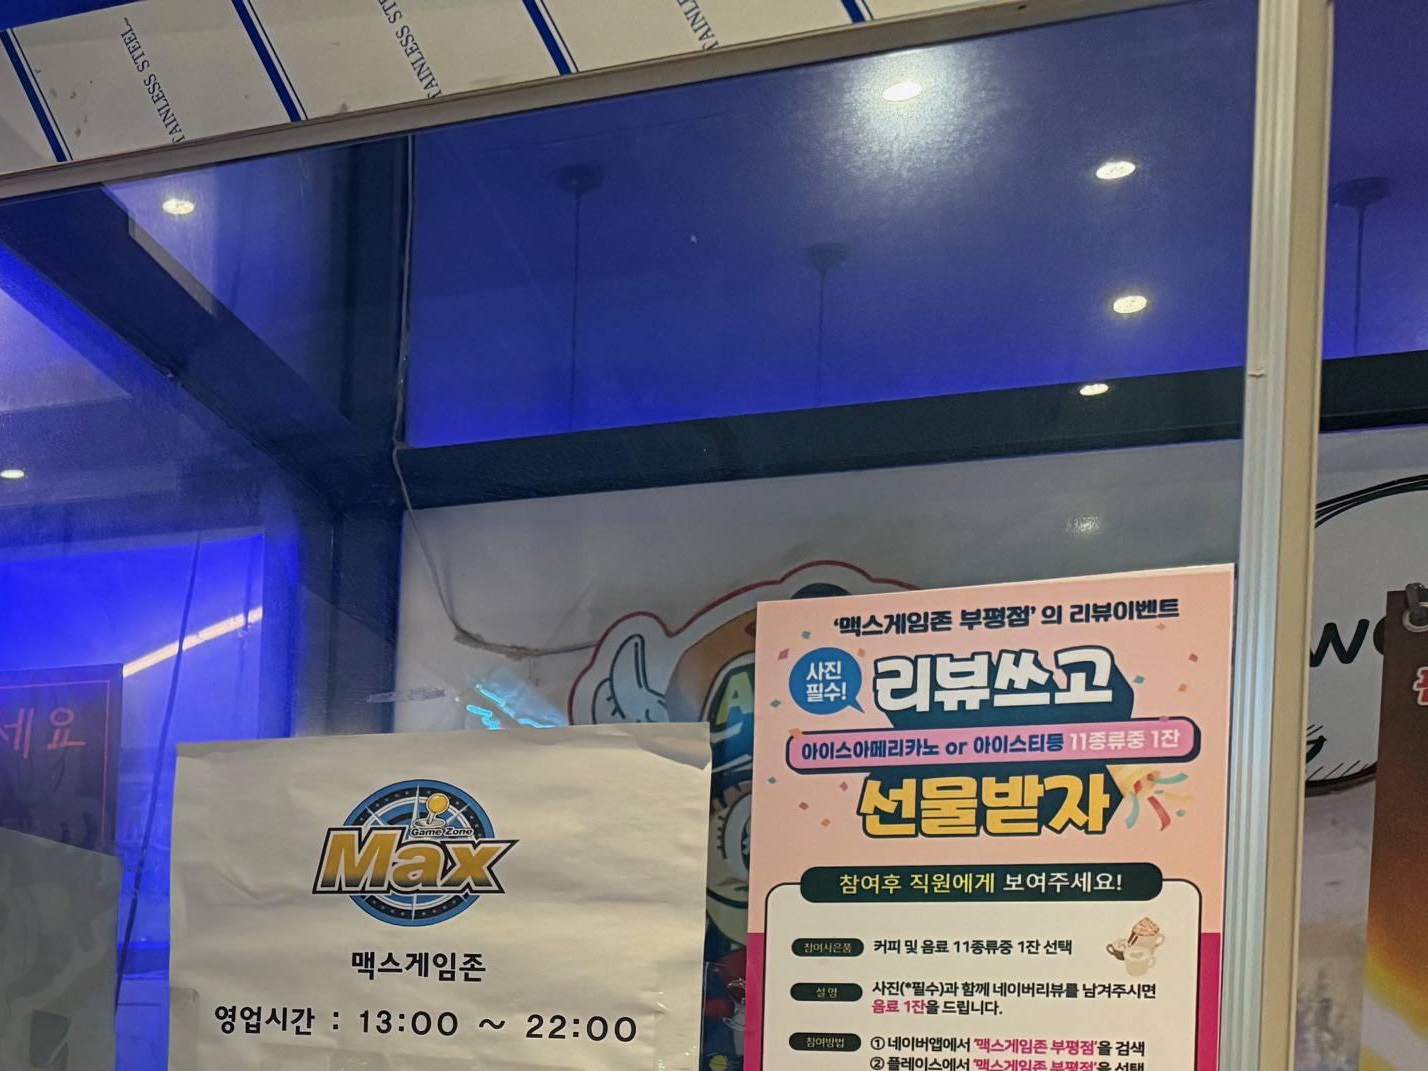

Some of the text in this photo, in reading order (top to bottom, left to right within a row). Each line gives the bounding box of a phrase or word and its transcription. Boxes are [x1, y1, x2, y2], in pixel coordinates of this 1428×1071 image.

[1041, 604, 1063, 626] 의
[1069, 596, 1181, 625] 리뷰이벤트
[805, 659, 843, 682] 사진
[874, 644, 1115, 714] 리뷰쓰고
[805, 680, 848, 703] 필수!
[801, 726, 1181, 762] 아이스아메리카노 or 아이스티등 11종류중 1잔
[859, 772, 1112, 838] 선물받자
[410, 826, 474, 838] Game Zone
[313, 828, 518, 893] Max
[839, 870, 1124, 896] 참여후 직원에게 보여주세요!
[873, 939, 902, 956] 커피
[904, 940, 919, 956] 및
[921, 940, 950, 955] 음료
[953, 939, 1014, 956] 11종류중
[1017, 939, 1041, 955] 1잔
[1042, 939, 1073, 956] 선택
[351, 951, 487, 983] 맥스게임존
[961, 982, 991, 998] 함께
[993, 982, 1080, 999] 네이버리뷰를
[1082, 983, 1157, 1001] 남겨주시면
[872, 1000, 1004, 1016] 음료 1잔을 드립니다.
[214, 1005, 316, 1036] 영업시간
[359, 1009, 459, 1037] 13:00
[525, 1013, 638, 1043] 22:00
[804, 1036, 846, 1050] 참여방법
[887, 1036, 972, 1053] 네이버앱에서
[1115, 1040, 1146, 1057] 검색
